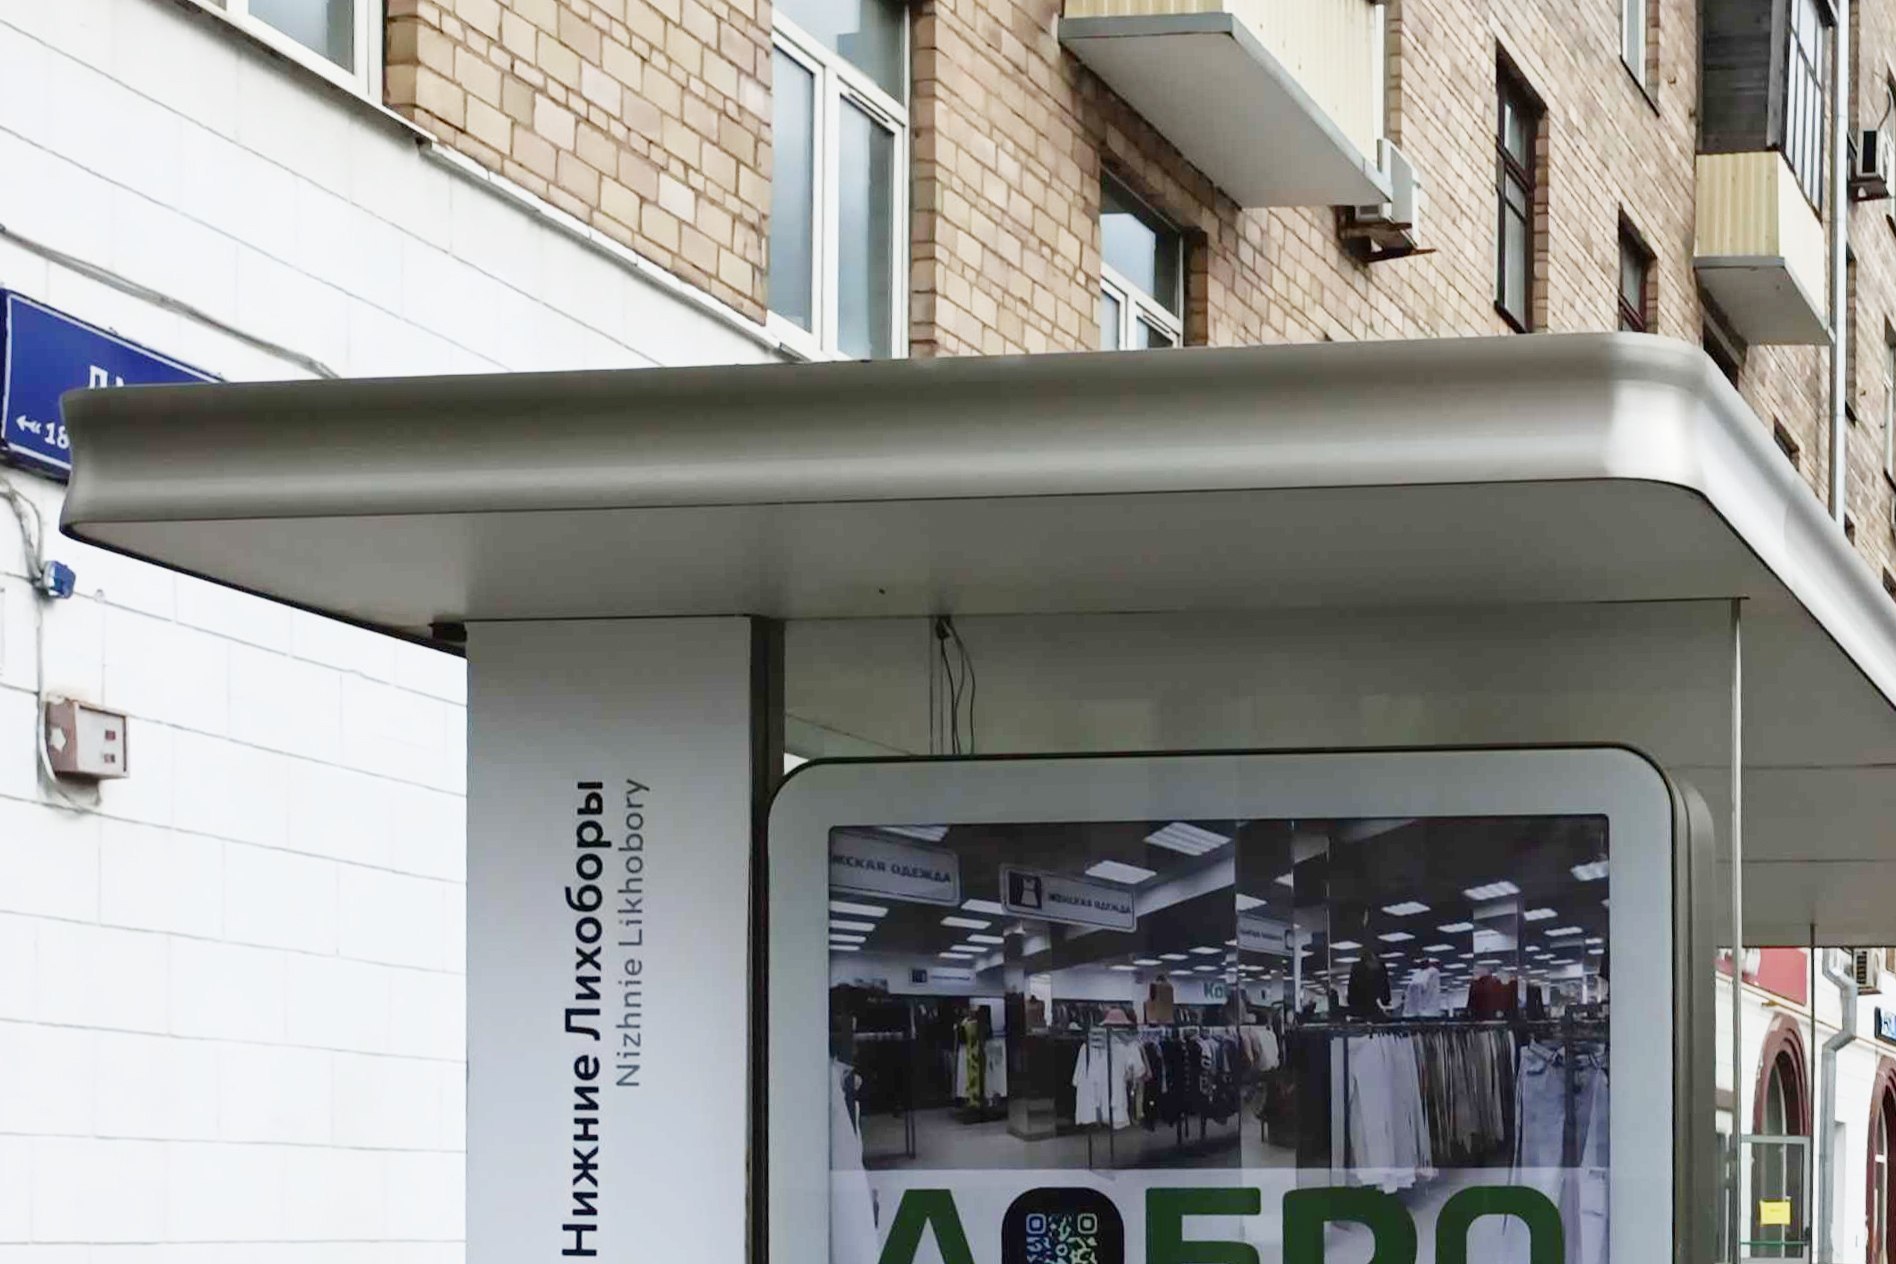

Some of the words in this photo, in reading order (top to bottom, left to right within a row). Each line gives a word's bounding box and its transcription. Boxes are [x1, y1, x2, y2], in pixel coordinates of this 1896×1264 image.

[564, 780, 612, 1041] Лихоборы
[617, 778, 650, 947] Likhobory
[615, 957, 643, 1088] Nizhnie
[561, 1053, 602, 1258] Нижние
